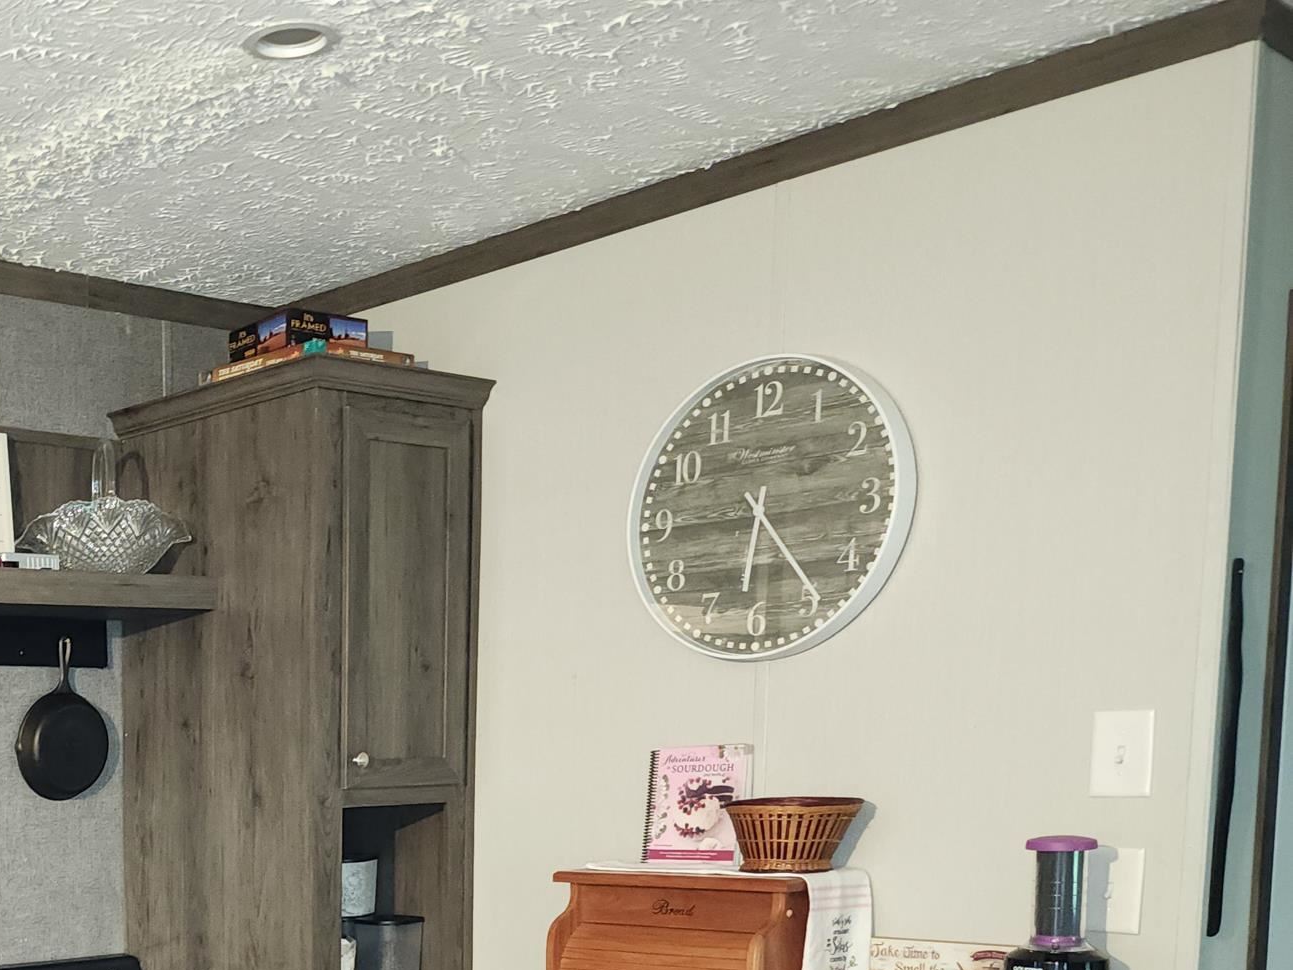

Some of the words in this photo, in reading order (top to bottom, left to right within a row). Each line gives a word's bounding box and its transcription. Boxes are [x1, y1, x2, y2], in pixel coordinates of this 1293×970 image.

[229, 334, 256, 350] FRAMED
[290, 319, 327, 333] FRAMED
[752, 380, 784, 419] 12
[811, 388, 823, 423] 1
[707, 410, 731, 446] 11
[846, 421, 868, 457] 2
[673, 450, 702, 486] 10
[859, 477, 881, 514] 3
[655, 508, 673, 542] 9
[836, 537, 860, 572] 4
[666, 560, 685, 592] 8
[701, 592, 721, 625] 7
[798, 582, 818, 617] 5
[747, 601, 767, 636] 6
[672, 764, 735, 773] SOURDOUGH
[652, 899, 696, 916] Bread
[870, 942, 899, 957] Take
[903, 945, 928, 959] Time
[931, 950, 940, 960] to
